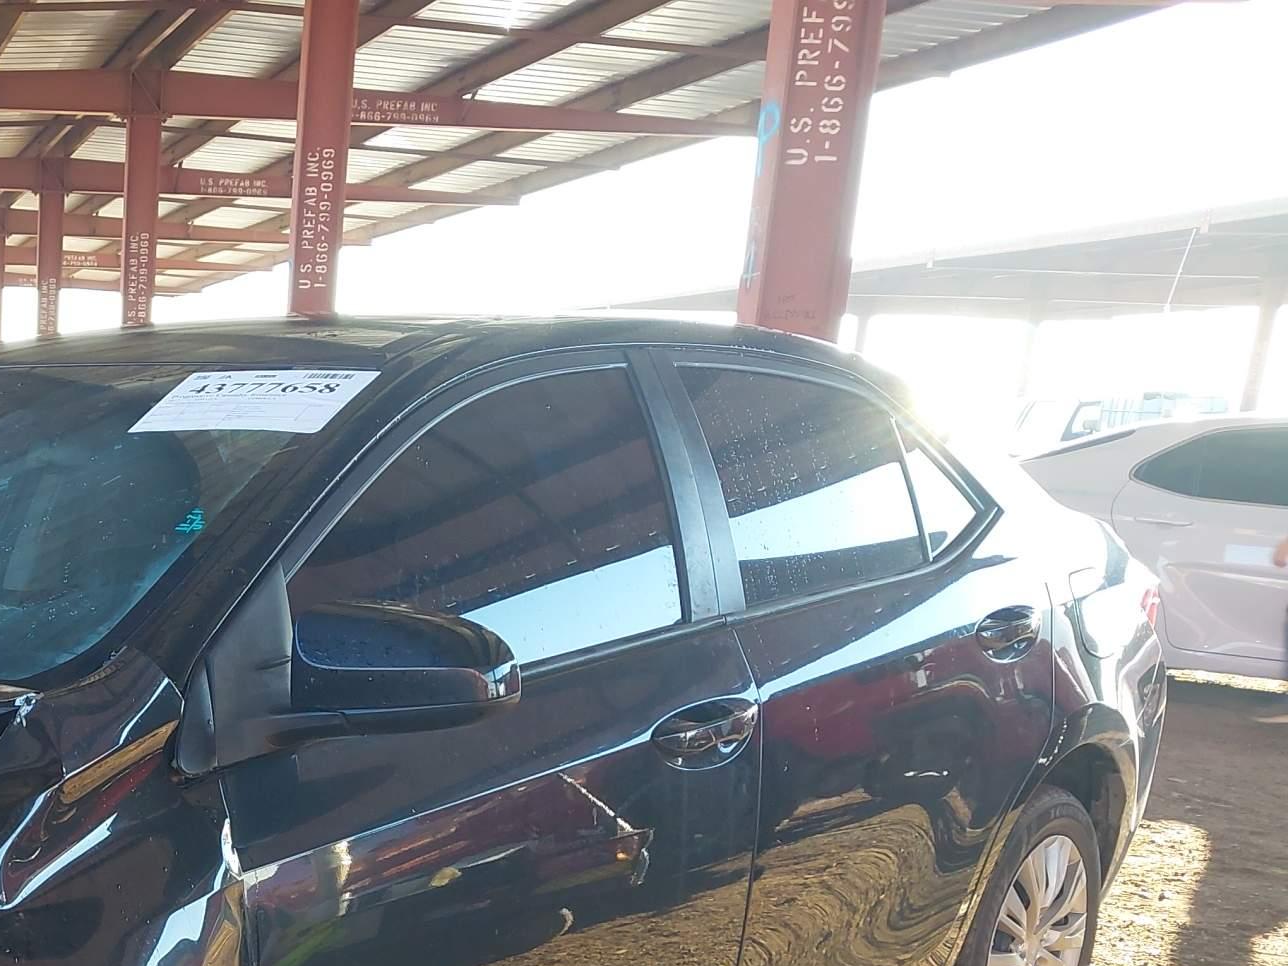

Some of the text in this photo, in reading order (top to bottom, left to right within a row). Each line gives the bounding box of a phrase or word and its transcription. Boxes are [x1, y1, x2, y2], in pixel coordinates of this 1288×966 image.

[376, 100, 416, 111] PREFAB
[784, 0, 825, 165] U.S. PREF
[301, 186, 318, 249] PREFAB
[314, 148, 336, 288] 1-866-799-0969
[189, 383, 340, 394] 43777658
